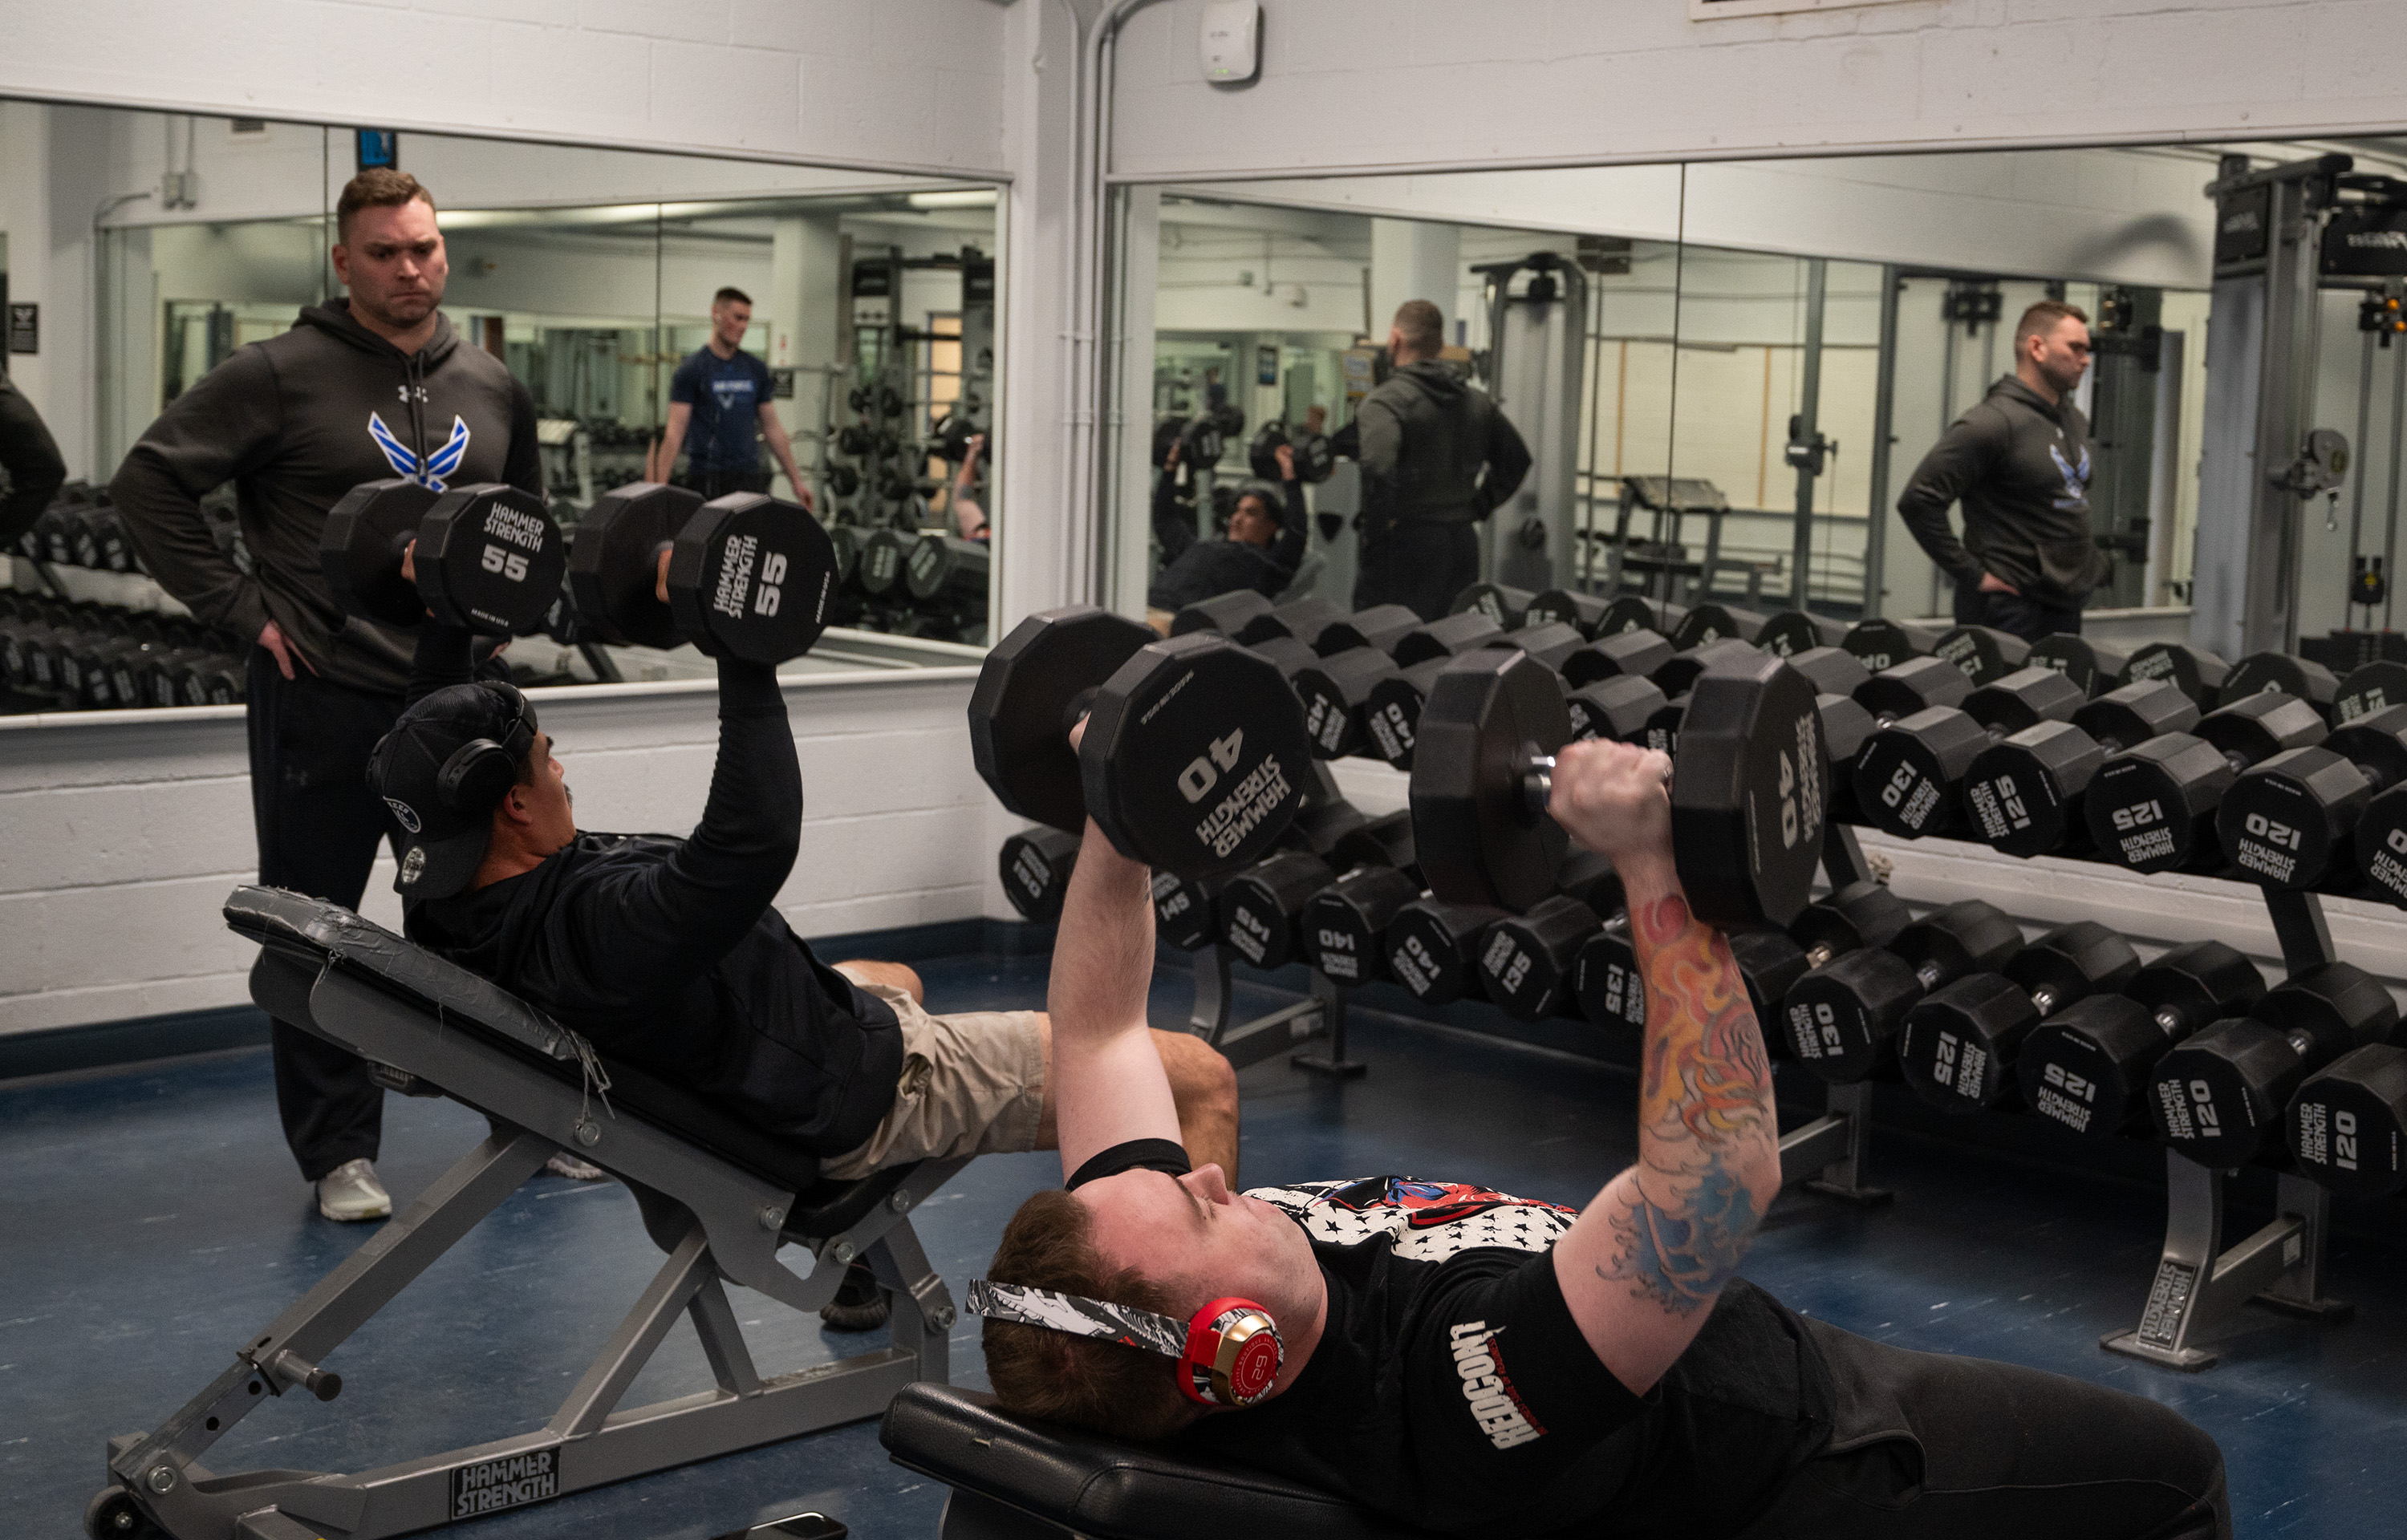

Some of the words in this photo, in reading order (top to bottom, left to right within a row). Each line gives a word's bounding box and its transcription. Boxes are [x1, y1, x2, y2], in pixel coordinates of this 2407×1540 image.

[483, 517, 544, 553] STRENGTH
[489, 500, 545, 536] HAMMER
[481, 543, 530, 583] 55
[713, 534, 742, 614] HAMMER
[728, 534, 758, 620] STRENGTH
[754, 550, 788, 618] 55
[1386, 702, 1415, 749] 140
[1177, 727, 1244, 804] 40
[1881, 759, 1918, 808] 130
[1195, 752, 1281, 846] STRENGTH
[1212, 772, 1292, 858] HAMMER
[1778, 748, 1798, 850] 40
[1898, 776, 1933, 825] STRENGTH
[1910, 786, 1941, 830] HAMMER
[1970, 788, 1999, 839] HAMMER
[1977, 780, 2011, 837] STRENGTH
[1995, 774, 2032, 830] 125
[2111, 799, 2164, 831] 125
[2120, 826, 2173, 853] STRENGTH
[2127, 837, 2176, 864] HAMMER
[2238, 837, 2296, 872] STRENGTH
[2245, 812, 2302, 851] 120
[2238, 851, 2293, 883] HAMMER
[2372, 849, 2407, 881] ENGTH
[1318, 928, 1356, 952] 140
[1405, 934, 1442, 980] 140
[1501, 950, 1532, 995] 135
[1605, 962, 1625, 1015] 135
[1815, 1002, 1845, 1056] 130
[1933, 1030, 1958, 1087] 125
[1956, 1040, 1975, 1097] STRENGTH
[1968, 1046, 1987, 1100] HAMMER
[2043, 1062, 2096, 1104] 125
[2038, 1085, 2092, 1123] STRENGTH
[2038, 1099, 2087, 1133] HAMMER
[2157, 1081, 2185, 1138] HAMMER
[2168, 1078, 2196, 1140] STRENGTH
[2189, 1079, 2222, 1137] 120
[2299, 1102, 2315, 1161] HAMMER
[2312, 1102, 2328, 1166] STRENGTH
[2335, 1109, 2357, 1171] 120
[1450, 1319, 1541, 1450] REDCON1
[457, 1472, 555, 1516] STRENGTH
[462, 1451, 552, 1494] HAMMER
